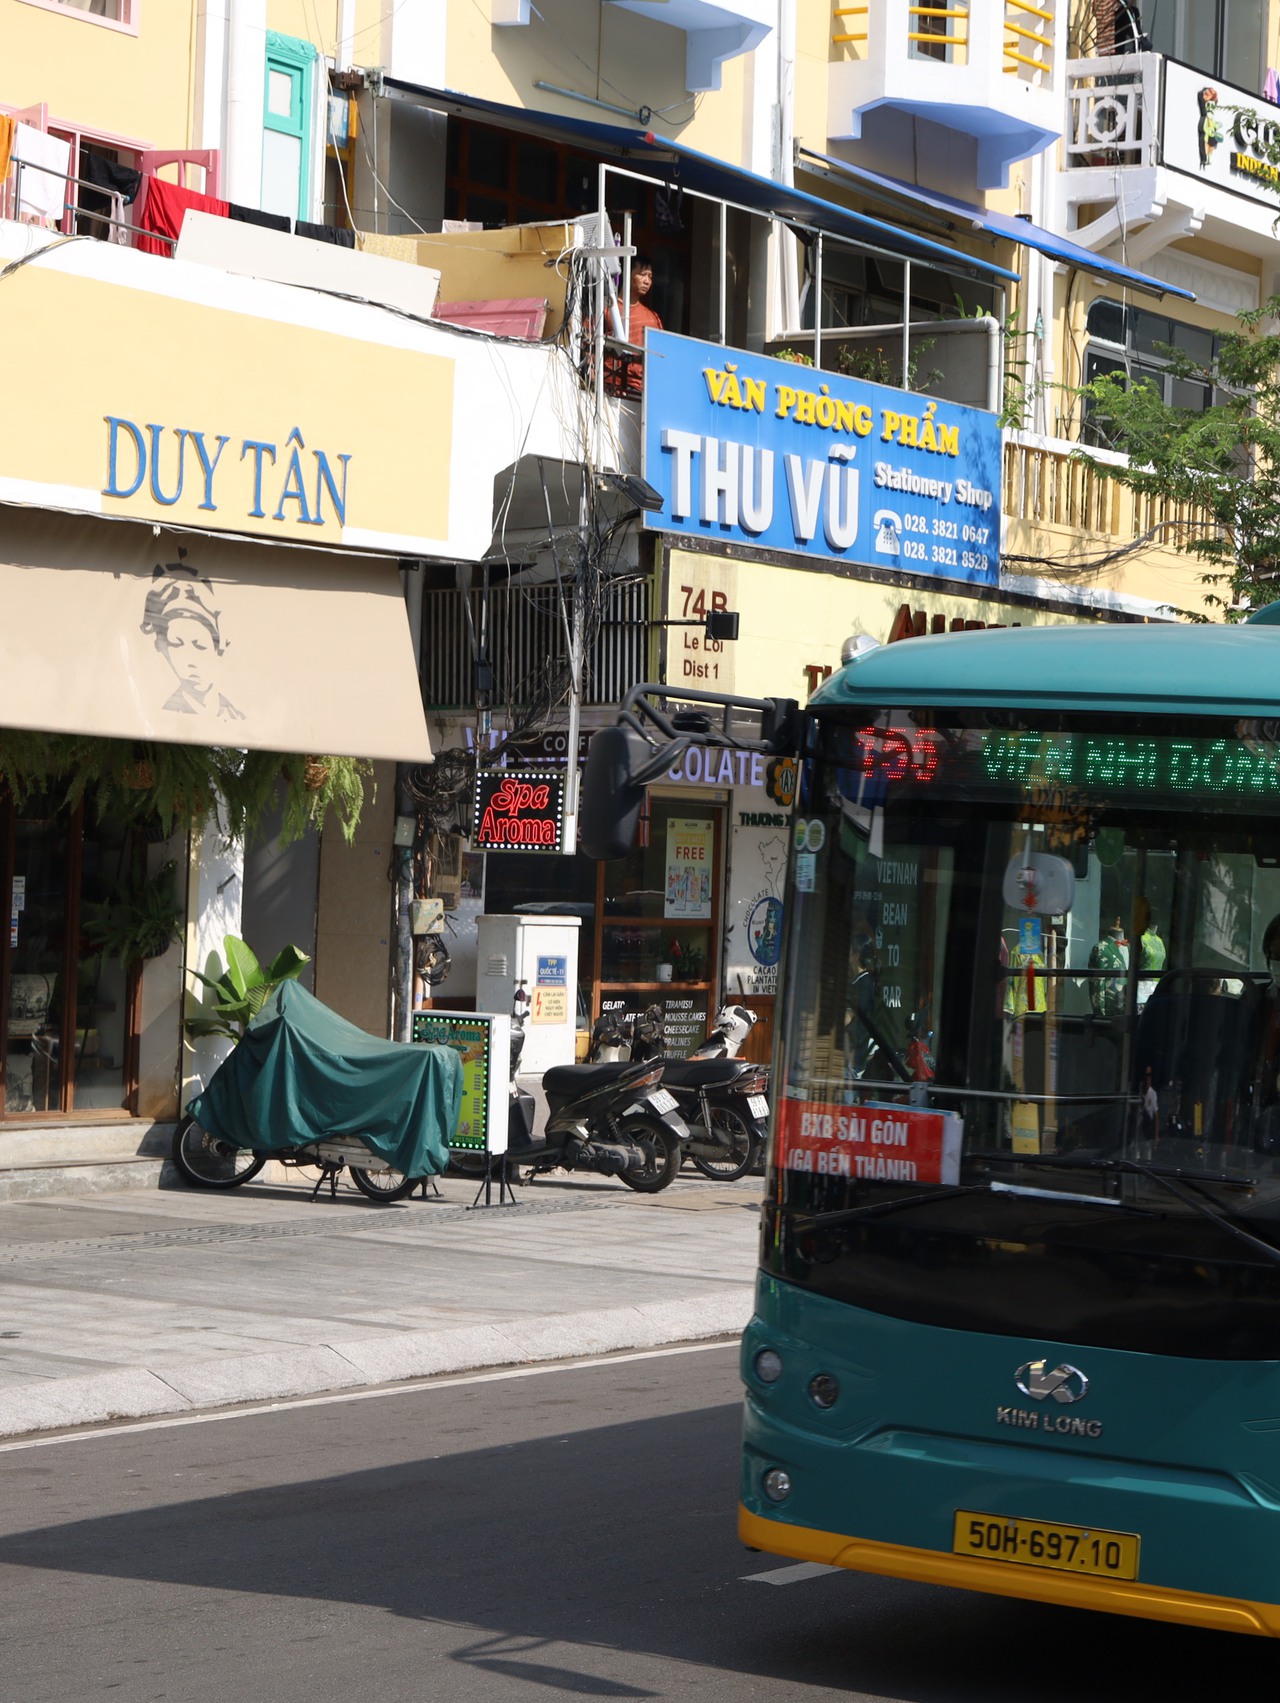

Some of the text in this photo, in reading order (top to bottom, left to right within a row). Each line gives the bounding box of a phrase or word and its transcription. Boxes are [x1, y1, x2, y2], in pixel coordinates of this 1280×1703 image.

[703, 362, 960, 457] VĂN PHÒNG PHẨM
[101, 415, 352, 529] DUY TÂN
[661, 429, 859, 549] THU VŨ
[873, 461, 993, 512] Stationery Shop
[904, 513, 989, 545] 028. 3821 0647
[903, 540, 988, 571] 028. 3821 8528
[684, 631, 699, 650] Le
[683, 659, 719, 679] Dist 1
[1086, 741, 1157, 788] NHI
[491, 778, 550, 816] Spa
[478, 807, 556, 844] Aroma
[676, 846, 705, 860] FREE
[877, 861, 918, 886] VIETNAM
[743, 888, 769, 928] CHOCOLATE
[883, 903, 908, 926] BEAN
[888, 945, 899, 967] TO
[753, 966, 777, 975] CACAO
[753, 985, 777, 993] IN VIET
[883, 986, 901, 1009] BAR
[664, 1012, 706, 1021] MOUSSE CAKES
[665, 1000, 693, 1008] TIRAMISU
[447, 1024, 481, 1042] Aroma
[664, 1025, 700, 1034] CHEESECAKE
[664, 1037, 691, 1046] PRALINES
[663, 1050, 687, 1059] TRUFFLE
[801, 1112, 908, 1146] BXB SÀI GÒN
[788, 1146, 917, 1181] (GA BẾN THÀNH)
[996, 1406, 1103, 1438] KIM LONG
[969, 1520, 1121, 1570] 50H-697.10
